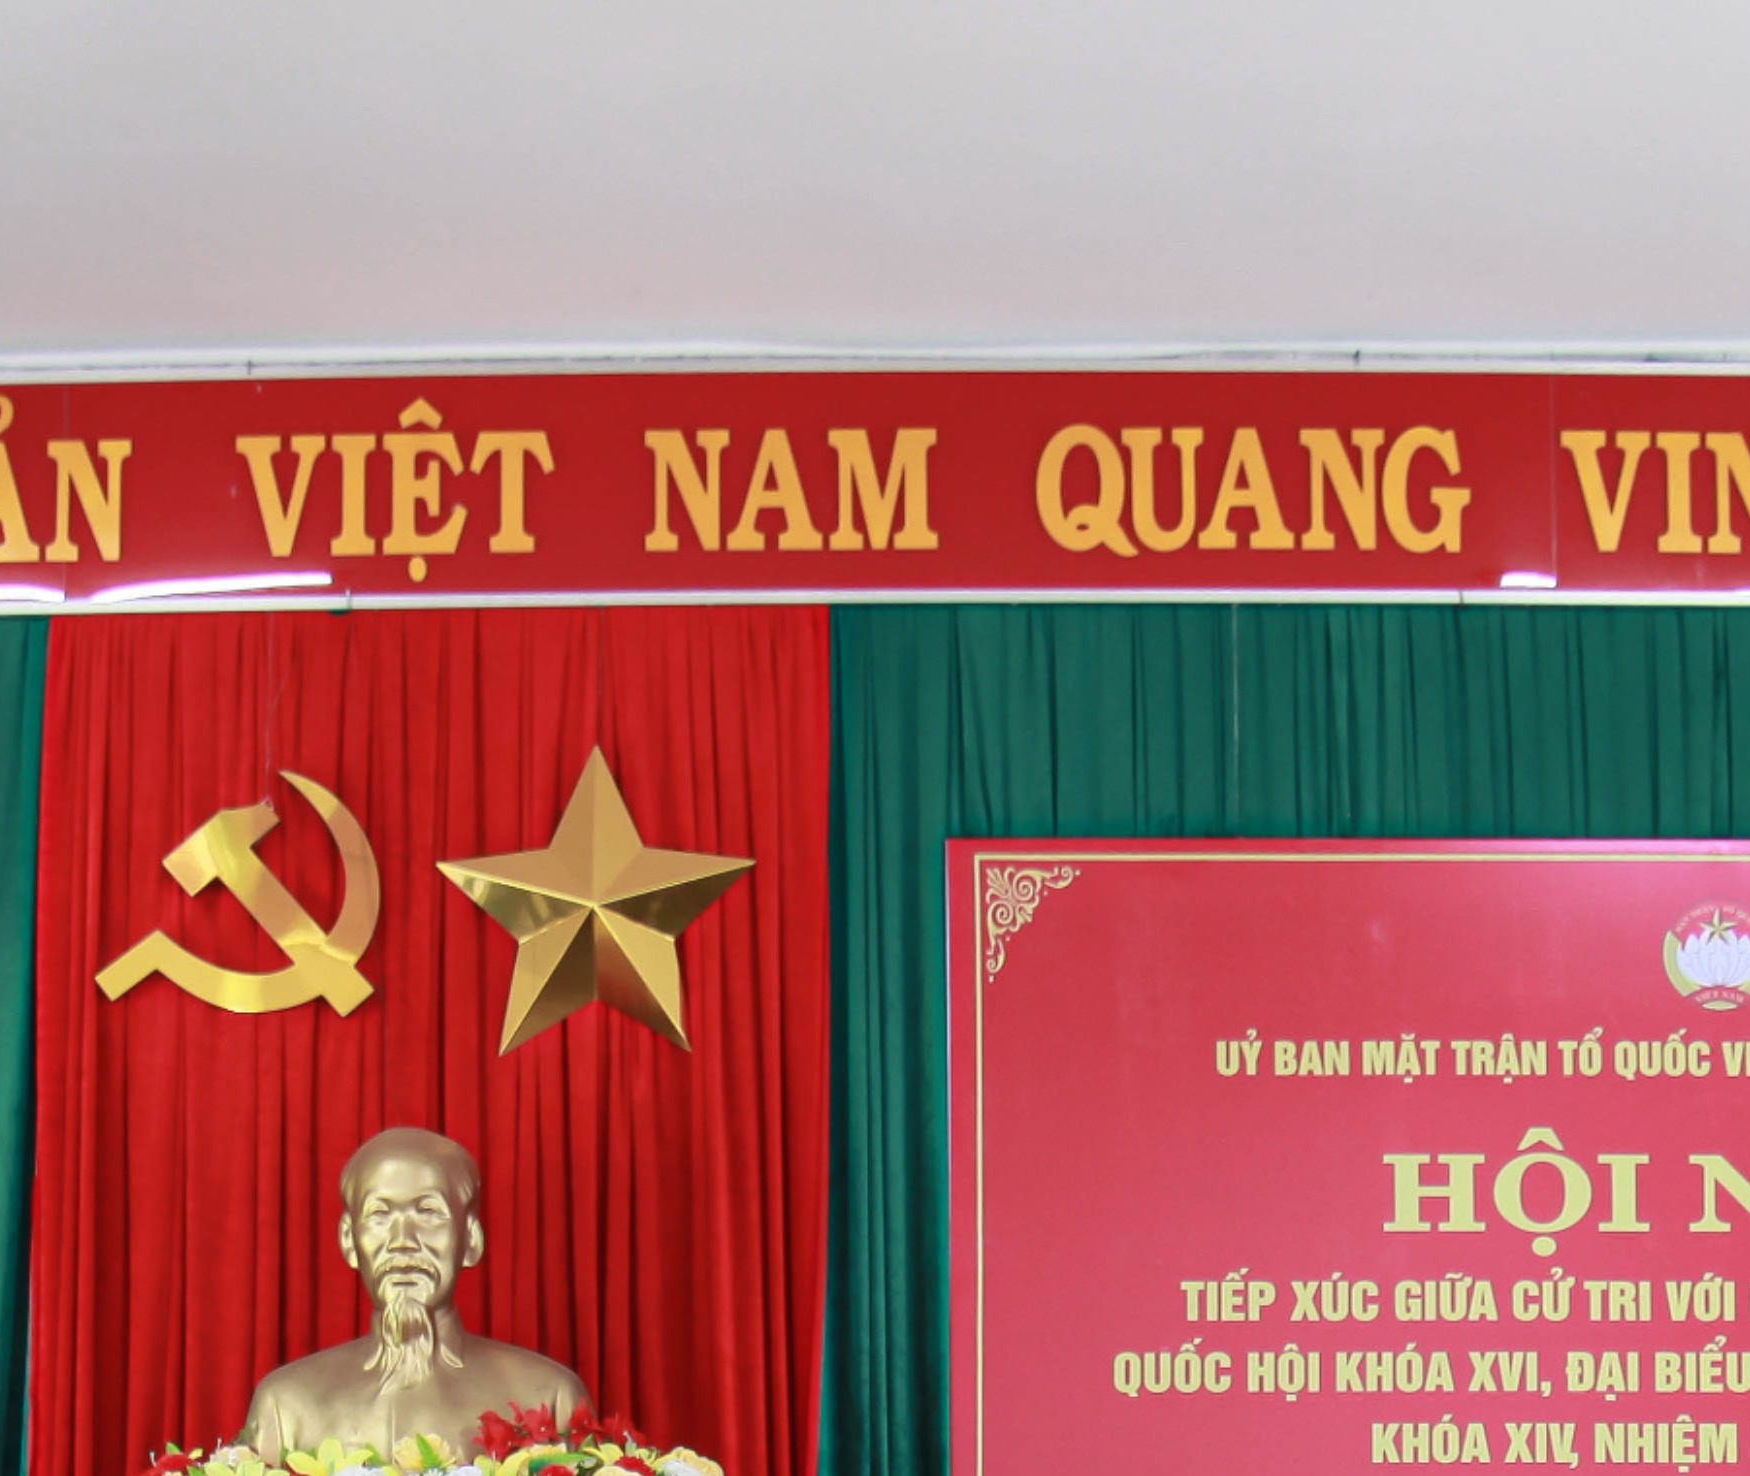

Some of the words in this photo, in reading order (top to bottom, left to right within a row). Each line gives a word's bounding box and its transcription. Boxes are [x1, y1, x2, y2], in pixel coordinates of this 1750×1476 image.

[236, 399, 555, 582] VIỆT
[645, 428, 938, 551] NAM
[1037, 425, 1471, 556] QUANG
[1217, 1029, 1262, 1076] UỶ
[1275, 1041, 1349, 1075] BAN
[1362, 1034, 1440, 1083] MẶT
[1451, 1033, 1547, 1083] TRẬN
[1558, 1027, 1603, 1076] TỔ
[1615, 1029, 1711, 1080] QUỐC
[1383, 1127, 1650, 1256] HỘI
[1181, 1268, 1275, 1321] TIẾP
[1291, 1272, 1379, 1321] XÚC
[1395, 1273, 1498, 1321] GIỮA
[1512, 1267, 1575, 1321] CỬ
[1583, 1281, 1651, 1321] TRI
[1665, 1272, 1735, 1321] VỚI
[1114, 1338, 1231, 1397] QUỐC
[1248, 1344, 1319, 1401] HỘI
[1336, 1343, 1454, 1392] KHÓA
[1469, 1352, 1551, 1397] XVI,
[1566, 1352, 1639, 1401] ĐẠI
[1372, 1414, 1490, 1463] KHÓA
[1505, 1423, 1578, 1468] XIV,
[1595, 1414, 1737, 1472] NHIỆM
